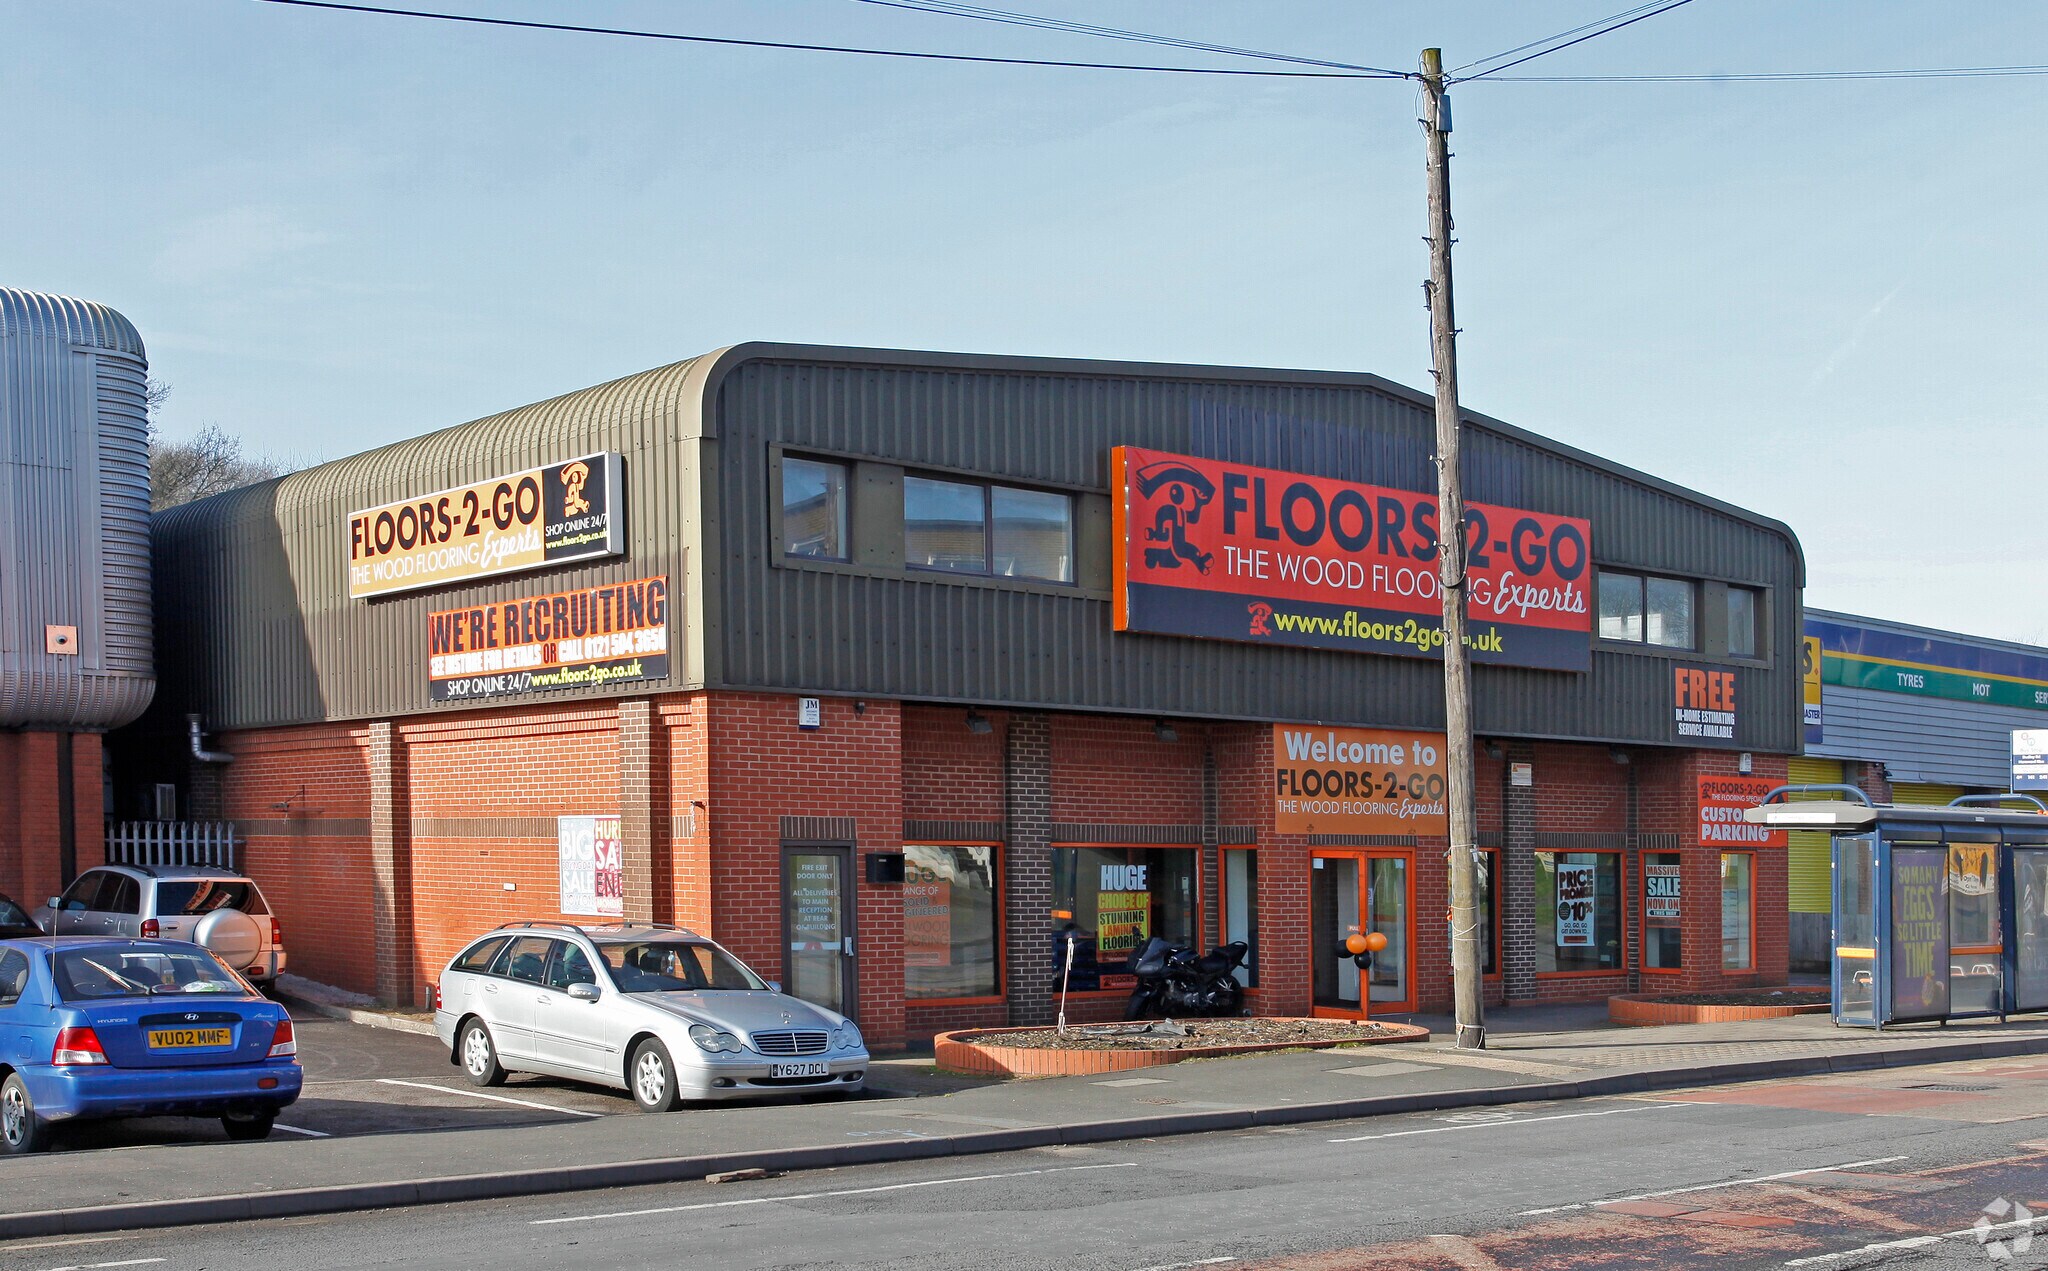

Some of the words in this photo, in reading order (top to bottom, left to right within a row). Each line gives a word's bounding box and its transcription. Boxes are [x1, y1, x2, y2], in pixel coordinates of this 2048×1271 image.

[351, 476, 540, 560] FLOORS-2-GO
[545, 523, 563, 537] SHOP
[565, 517, 589, 533] ONLINE
[591, 513, 606, 527] 24/7
[1222, 472, 1586, 581] FLOORS2-GO
[545, 528, 607, 549] www.floors2go.co.uk
[352, 566, 370, 585] THE
[373, 558, 413, 581] WOOD
[417, 542, 480, 574] FLOORING
[481, 525, 541, 567] Experts
[1223, 545, 1269, 580] THE
[1277, 555, 1365, 590] WOOD
[1372, 565, 1492, 606] FLOOG
[1495, 571, 1586, 618] Experts
[432, 604, 497, 655] WE'RE
[505, 579, 666, 647] RECRUITING
[1274, 610, 1502, 653] www.floors2go.uk
[431, 656, 445, 676] SEE
[484, 649, 502, 671] FOR
[503, 644, 541, 668] DETAILS
[543, 643, 557, 664] OR
[559, 638, 583, 662] CALL
[585, 634, 609, 659] 0121
[611, 631, 634, 656] 504
[448, 679, 471, 696] SHOP
[472, 677, 505, 695] ONLINE
[508, 672, 531, 692] 24/7
[532, 659, 642, 687] www.floors2go.co.uk
[1675, 667, 1736, 711] FREE
[1897, 672, 1924, 689] TYRES
[1972, 683, 1991, 697] MOT
[2035, 691, 2048, 704] SER
[805, 700, 818, 709] JM
[1675, 708, 1701, 723] IN-HOME
[1701, 711, 1735, 725] ESTIMATING
[1804, 709, 1821, 720] ASTER
[1678, 723, 1703, 737] SERVICE
[1703, 724, 1733, 738] AVAILABLE
[1284, 731, 1405, 765] Welcome
[1412, 740, 1437, 767] to
[1277, 769, 1445, 801] FLOORS-2-GO
[1711, 782, 1770, 796] FLOORS-2-GO
[1721, 794, 1745, 802] FLOORING
[1278, 801, 1298, 814] THE
[1300, 801, 1340, 815] WOOD
[1343, 801, 1399, 816] FLOORING
[1399, 798, 1445, 819] Experts
[1701, 806, 1744, 822] CUSTO
[595, 820, 622, 840] HUR
[1701, 824, 1770, 842] PARKING
[562, 830, 593, 861] BIG
[1101, 865, 1147, 891] HUGE
[1559, 869, 1593, 888] PRICE
[1898, 866, 1909, 884] SO
[1910, 866, 1939, 884] MANY
[904, 886, 926, 895] ANGE
[928, 886, 939, 895] OF
[1648, 877, 1680, 896] SALE
[904, 896, 929, 907] SOLID
[1098, 893, 1136, 909] CHOICE
[1136, 893, 1149, 909] OF
[1648, 898, 1666, 909] NOW
[1668, 898, 1679, 909] ON
[1903, 886, 1935, 921] EGGS
[905, 906, 949, 918] GINEERED
[1100, 910, 1144, 925] STUNNING
[904, 933, 949, 946] OORING
[1103, 923, 1142, 937] LAMINAE
[1909, 922, 1942, 941] LITTLE
[1103, 934, 1144, 950] FLOORIG
[1904, 942, 1935, 978] TIME
[155, 1031, 194, 1045] VU02
[198, 1030, 225, 1044] MMF
[779, 1064, 806, 1076] Y627
[808, 1063, 827, 1075] DCL
